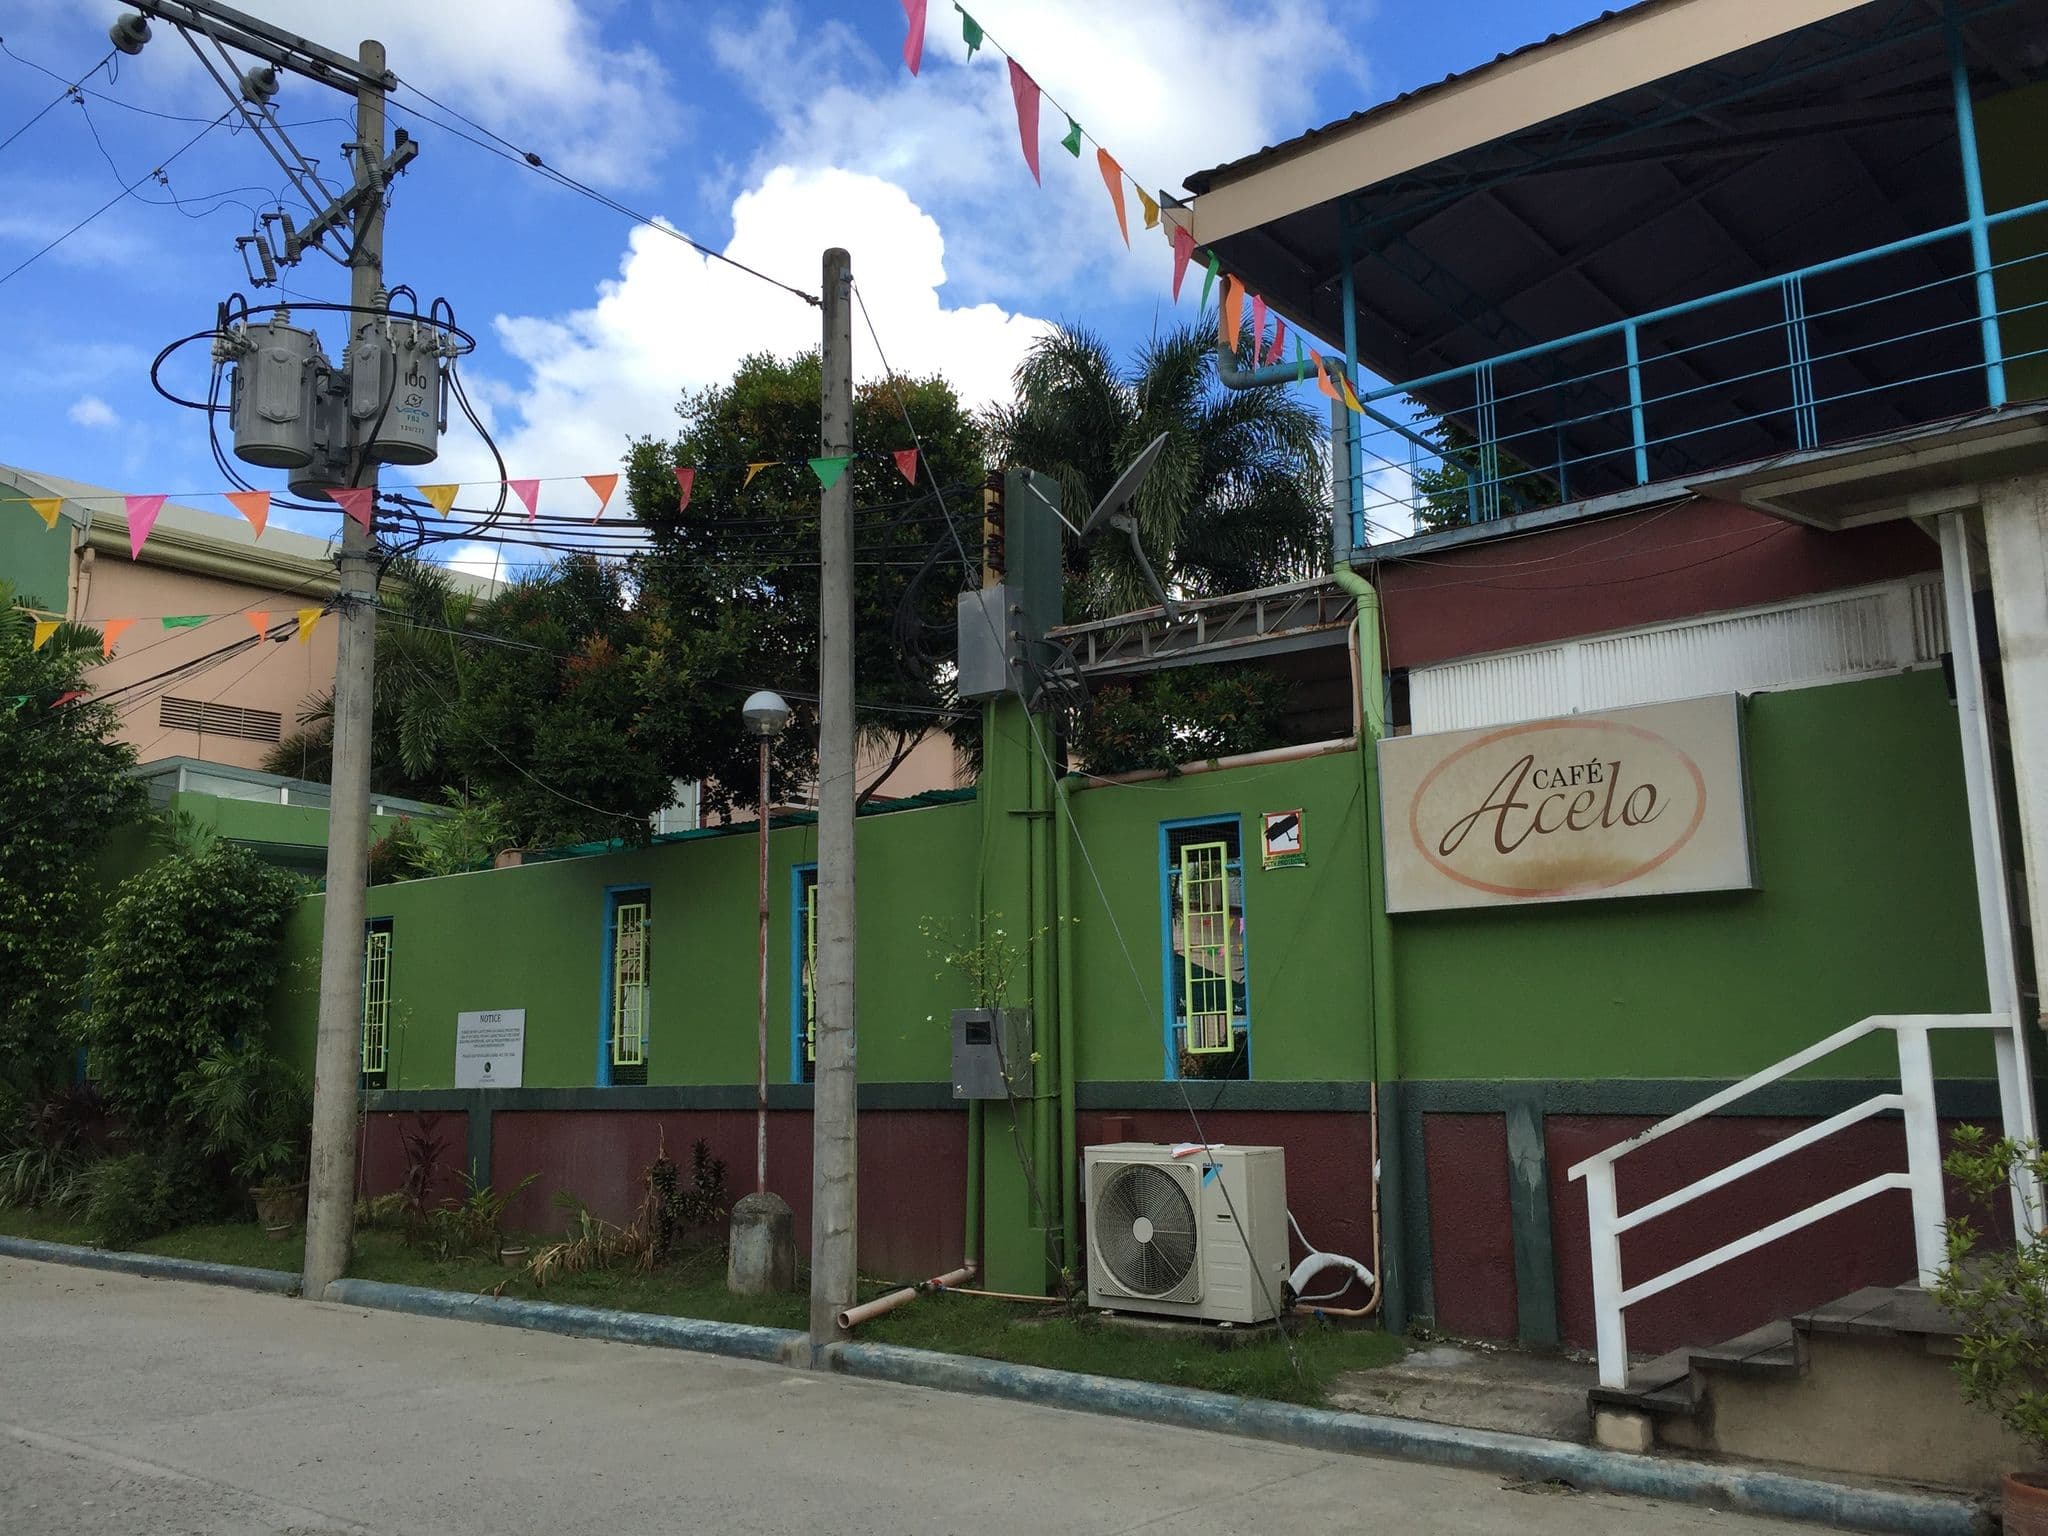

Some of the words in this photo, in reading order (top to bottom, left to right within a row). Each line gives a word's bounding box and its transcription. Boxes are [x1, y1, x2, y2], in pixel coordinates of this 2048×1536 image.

[405, 371, 427, 390] 100
[1532, 758, 1604, 790] CAFÉ
[1438, 753, 1671, 857] Acelo
[479, 1013, 502, 1024] NOTICE
